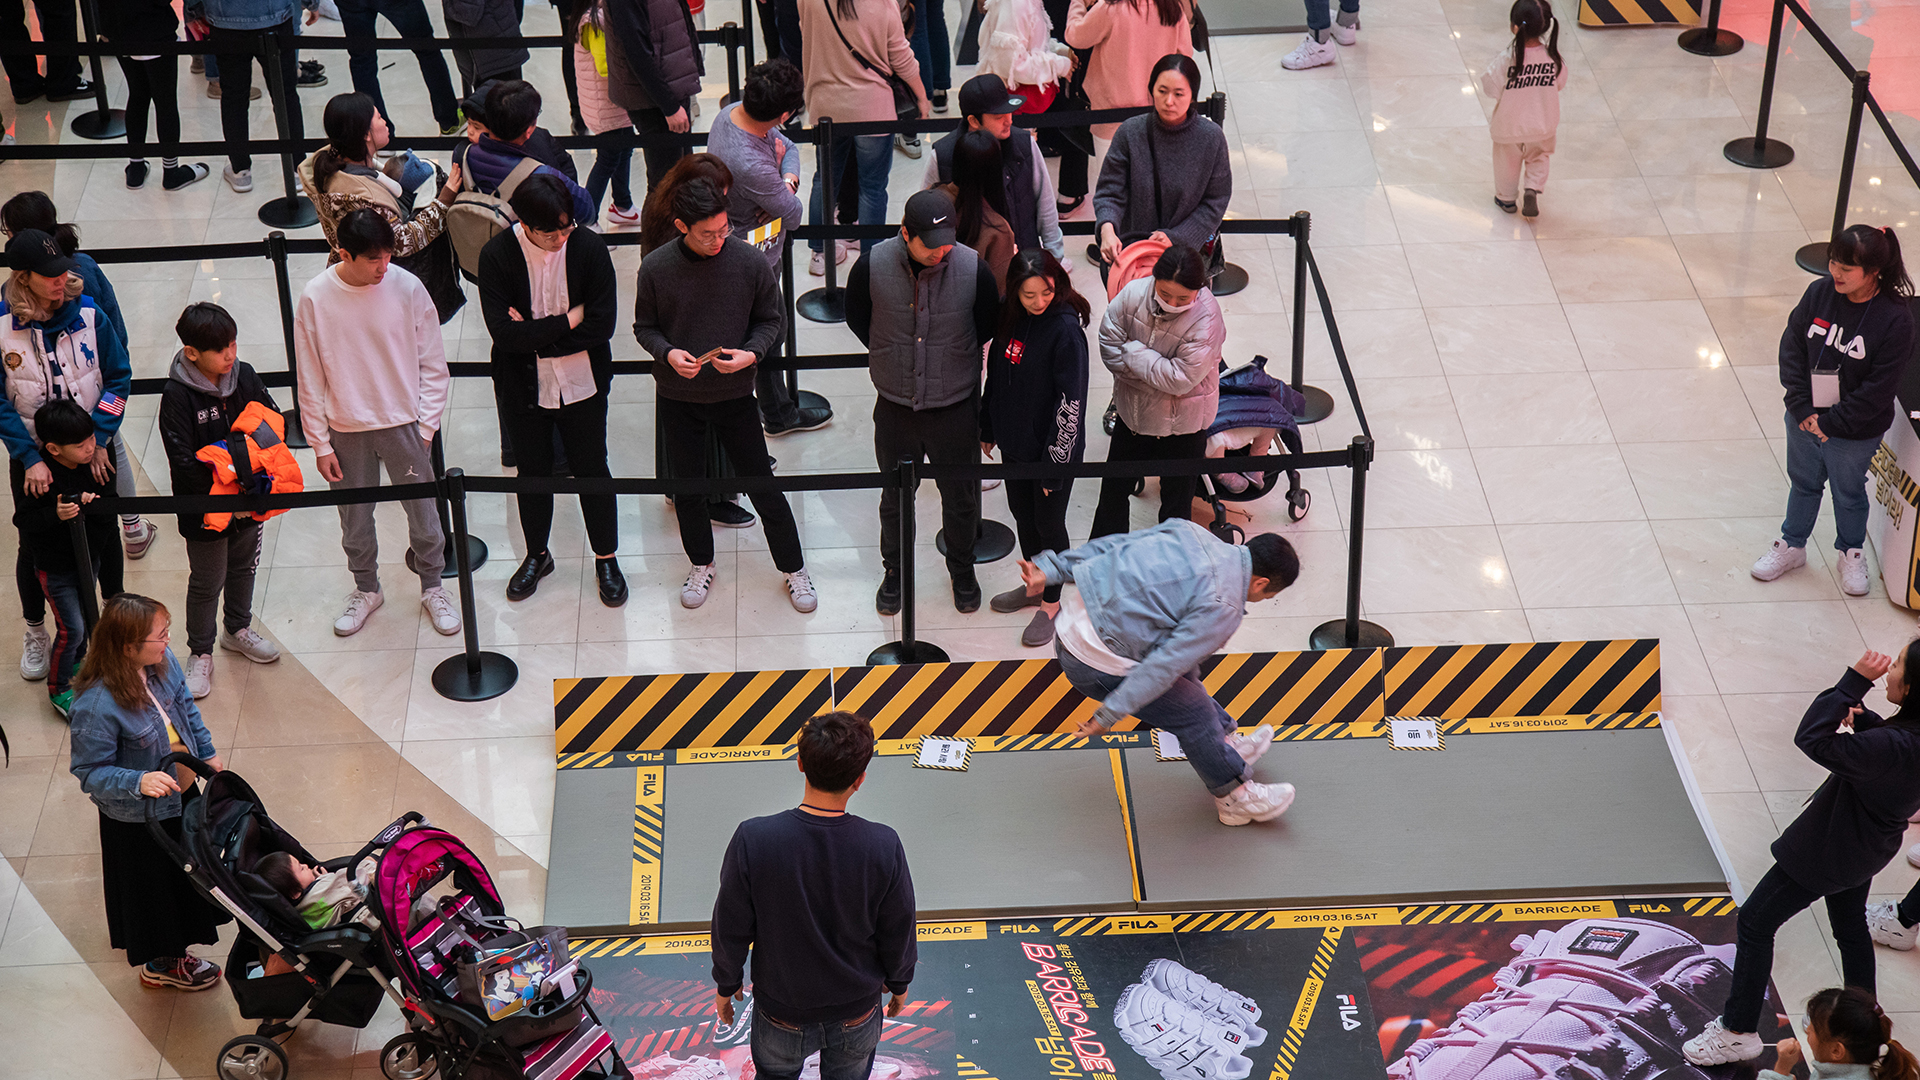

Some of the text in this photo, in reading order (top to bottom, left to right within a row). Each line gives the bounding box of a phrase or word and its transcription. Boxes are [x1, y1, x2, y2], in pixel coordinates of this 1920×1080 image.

[1807, 317, 1866, 360] FILA
[1489, 719, 1568, 728] 2019.03.16.SAT
[1101, 734, 1140, 744] FILA
[626, 752, 664, 762] FILA
[689, 749, 771, 760] BARRICADE
[643, 773, 656, 797] FILA
[1514, 903, 1672, 915] BARRICADE FILA
[1294, 912, 1378, 923] 2019.03.16.SAT
[1000, 924, 1040, 934] FILA
[1118, 920, 1158, 931] FILA
[1028, 982, 1059, 1034] 2019.03.16.SAT
[1296, 982, 1318, 1027] 2019.03.16.SAT
[1335, 994, 1362, 1031] FILA
